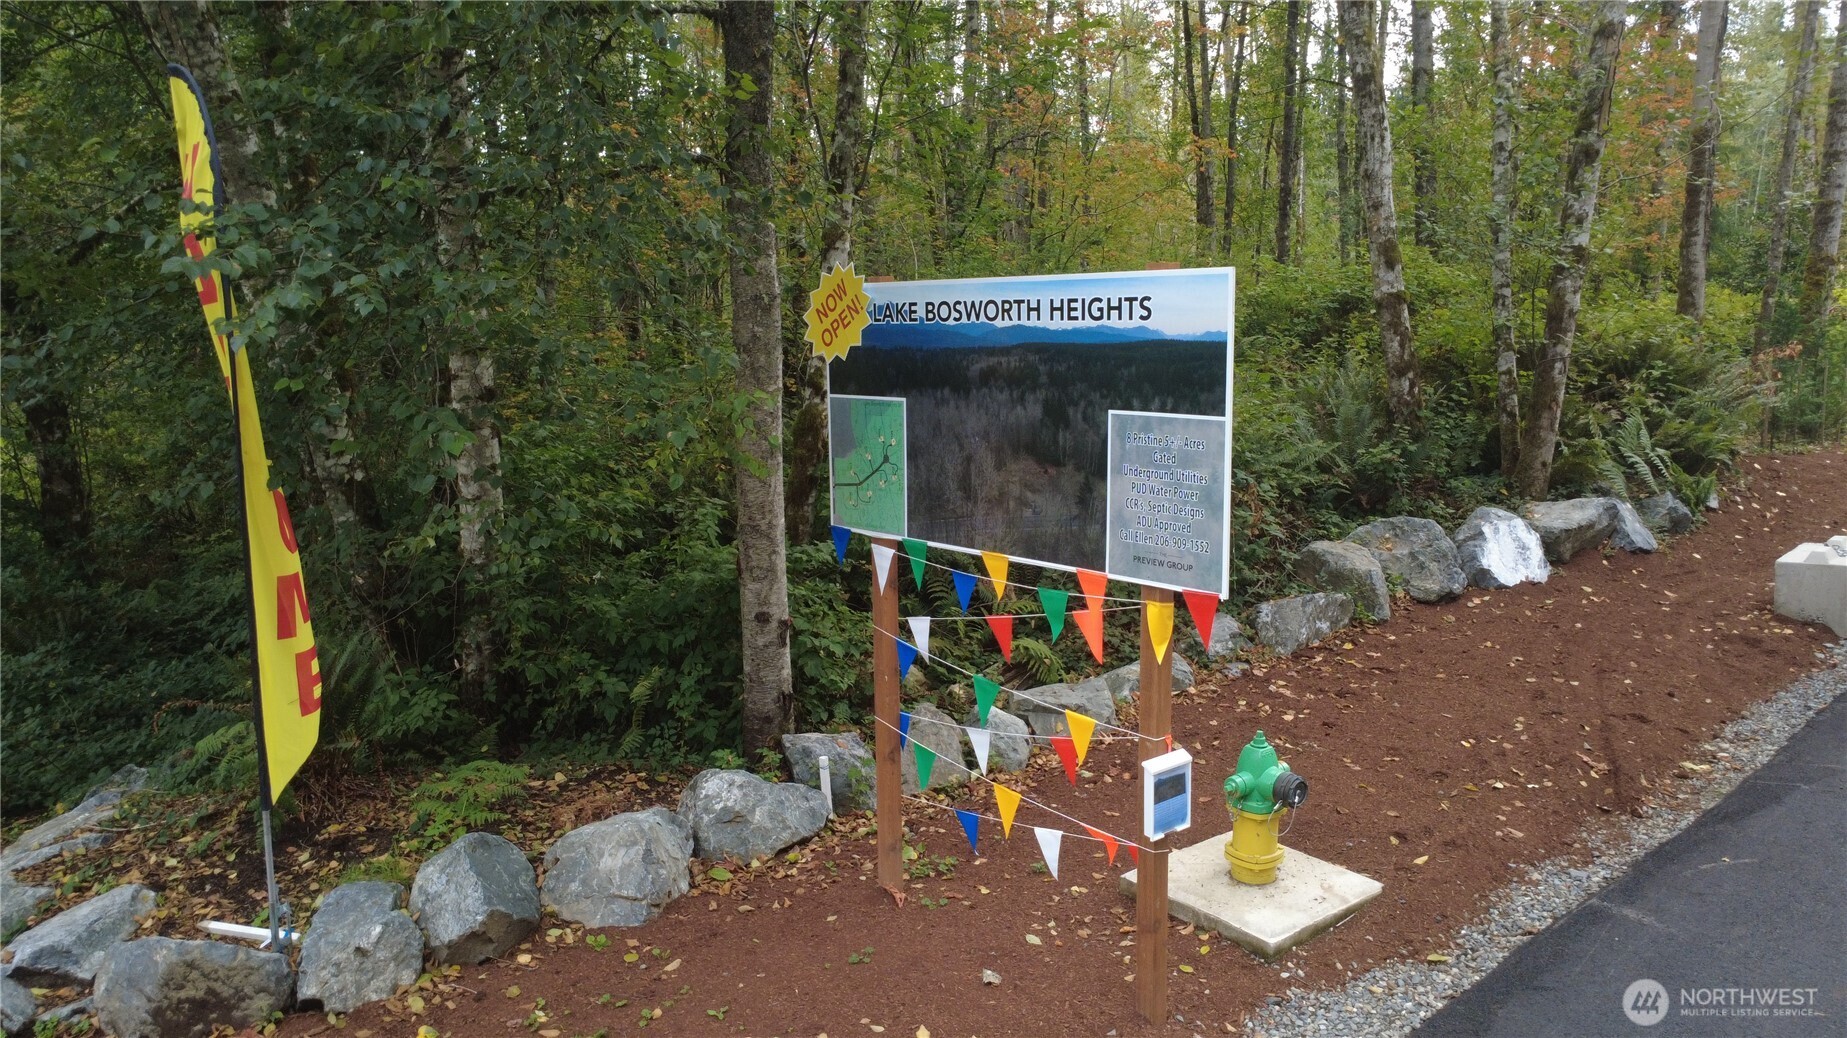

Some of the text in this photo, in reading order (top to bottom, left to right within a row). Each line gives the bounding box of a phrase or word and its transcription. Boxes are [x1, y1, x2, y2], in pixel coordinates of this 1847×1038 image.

[815, 277, 848, 325] NOW
[873, 295, 1153, 323] LAKE BOSWORTH HEIGHTS
[821, 294, 864, 348] OPEN!
[1126, 432, 1132, 444] 8
[1133, 432, 1163, 447] Pristine
[1183, 436, 1205, 450] Acres
[1152, 451, 1177, 465] Gated
[1123, 464, 1208, 485] Underground Utilities
[1131, 481, 1199, 501] PUD Water Power
[1147, 500, 1172, 515] Septic
[1173, 503, 1205, 521] Designs
[1136, 515, 1192, 534] ADU Approved
[1119, 529, 1210, 554] Call Ellen 206-909-1552
[1133, 555, 1194, 572] PREVIEW GROUP
